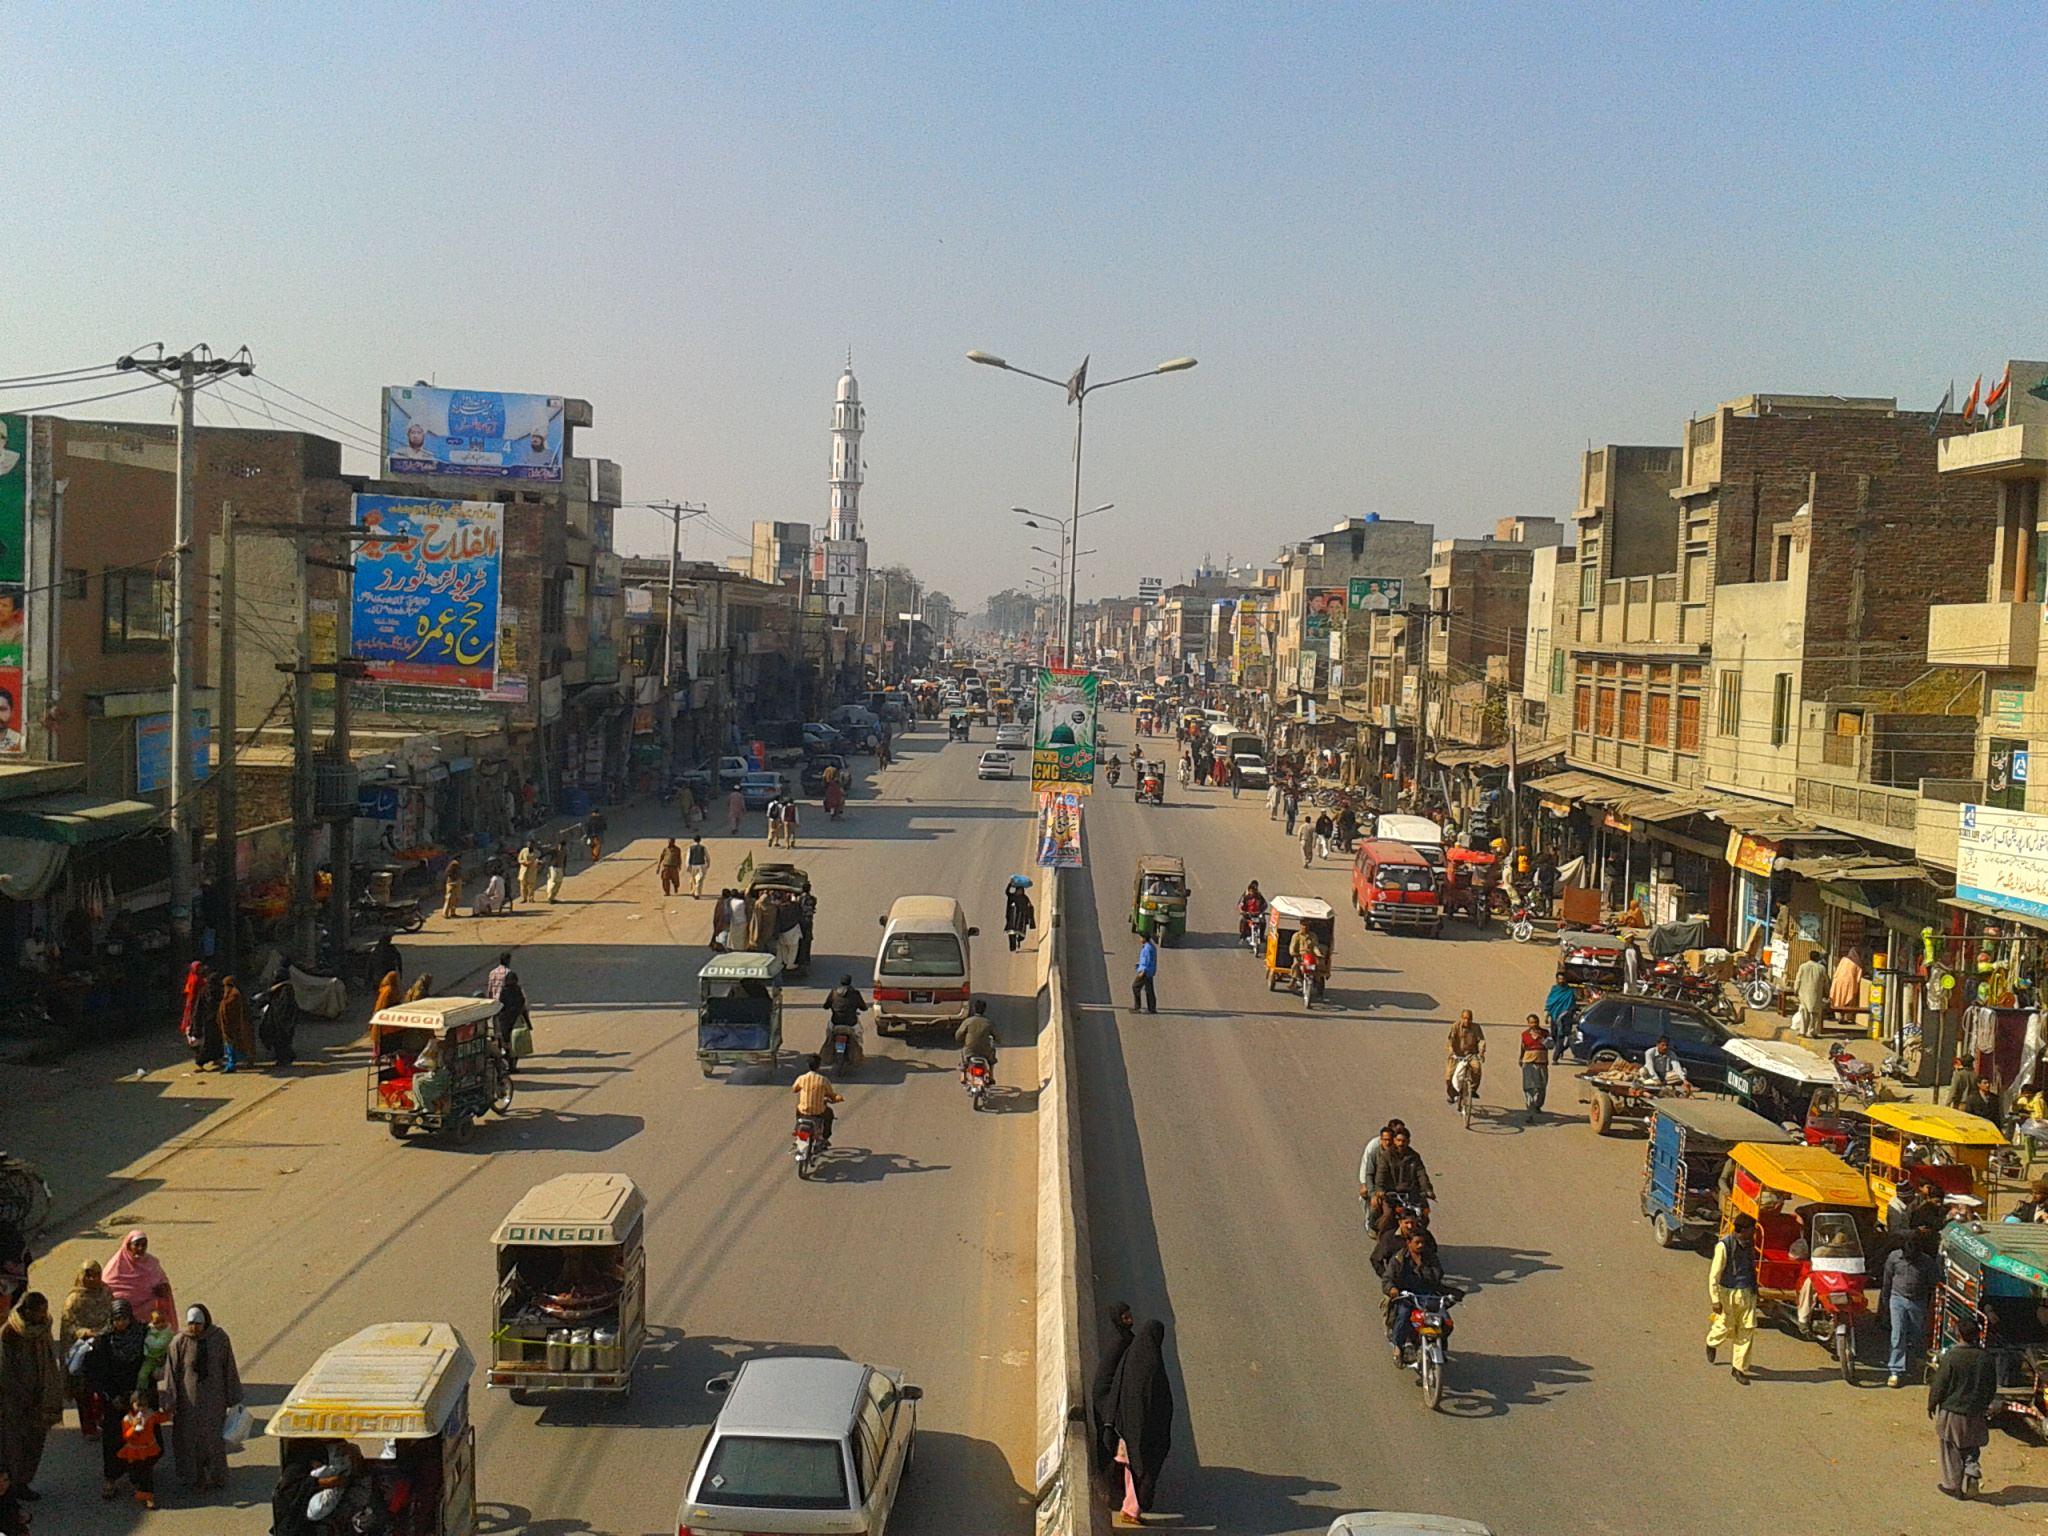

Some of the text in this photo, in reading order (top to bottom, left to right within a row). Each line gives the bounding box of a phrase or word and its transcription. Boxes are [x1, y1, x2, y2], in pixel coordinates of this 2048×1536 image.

[421, 523, 497, 563] الفلاح
[455, 602, 493, 665] حج
[1033, 763, 1060, 780] CNG
[508, 1228, 605, 1241] QINGQI
